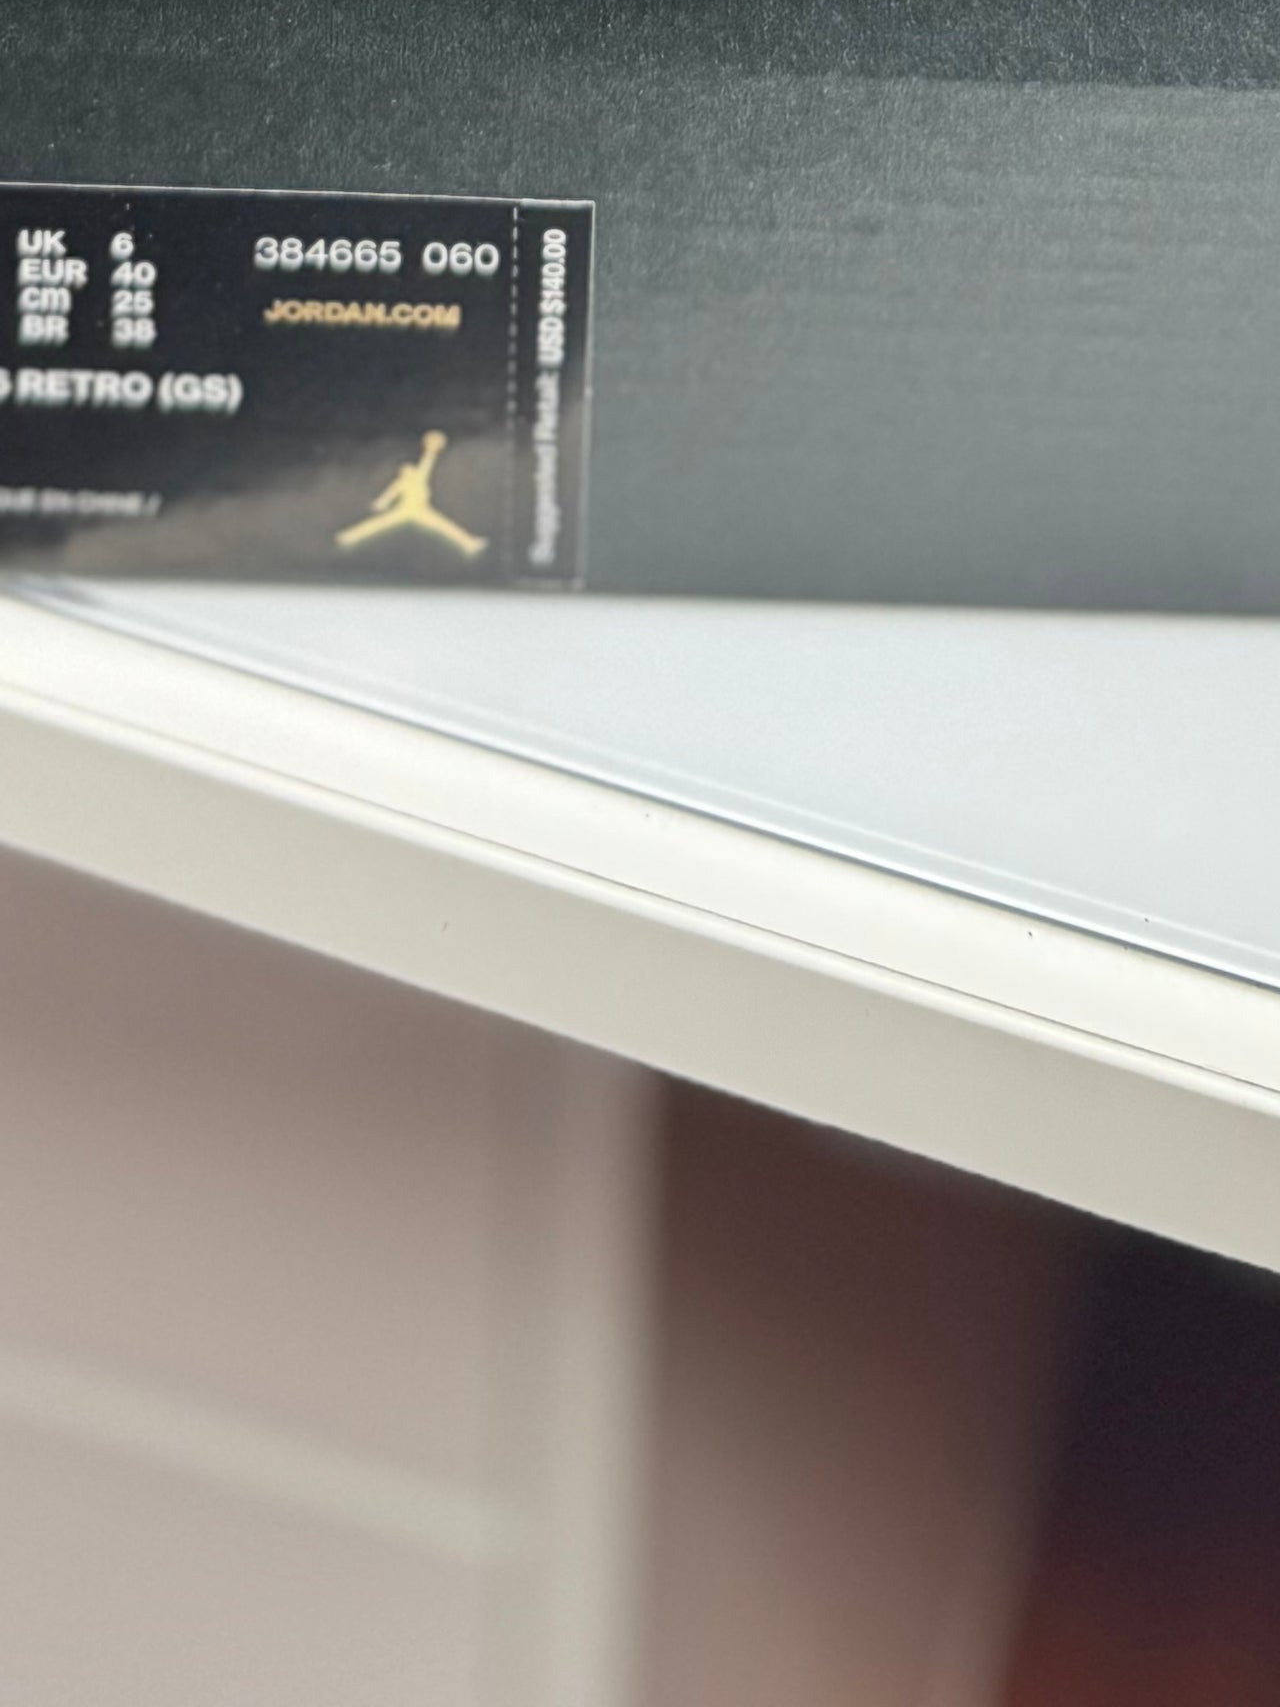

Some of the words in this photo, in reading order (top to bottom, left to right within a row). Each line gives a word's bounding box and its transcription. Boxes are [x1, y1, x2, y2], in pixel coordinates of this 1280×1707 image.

[19, 229, 66, 256] UK
[110, 232, 134, 258] 6
[254, 236, 402, 272] 384665
[422, 241, 500, 275] 060
[19, 258, 88, 287] EUR
[112, 261, 156, 289] 40
[539, 228, 567, 316] $140.00
[113, 290, 153, 318] 25
[263, 300, 462, 330] JORDAN.COM
[19, 316, 69, 346] BR
[112, 319, 157, 347] 38
[536, 317, 565, 368] USD
[17, 370, 153, 407] RETRO
[158, 374, 244, 413] (GS)
